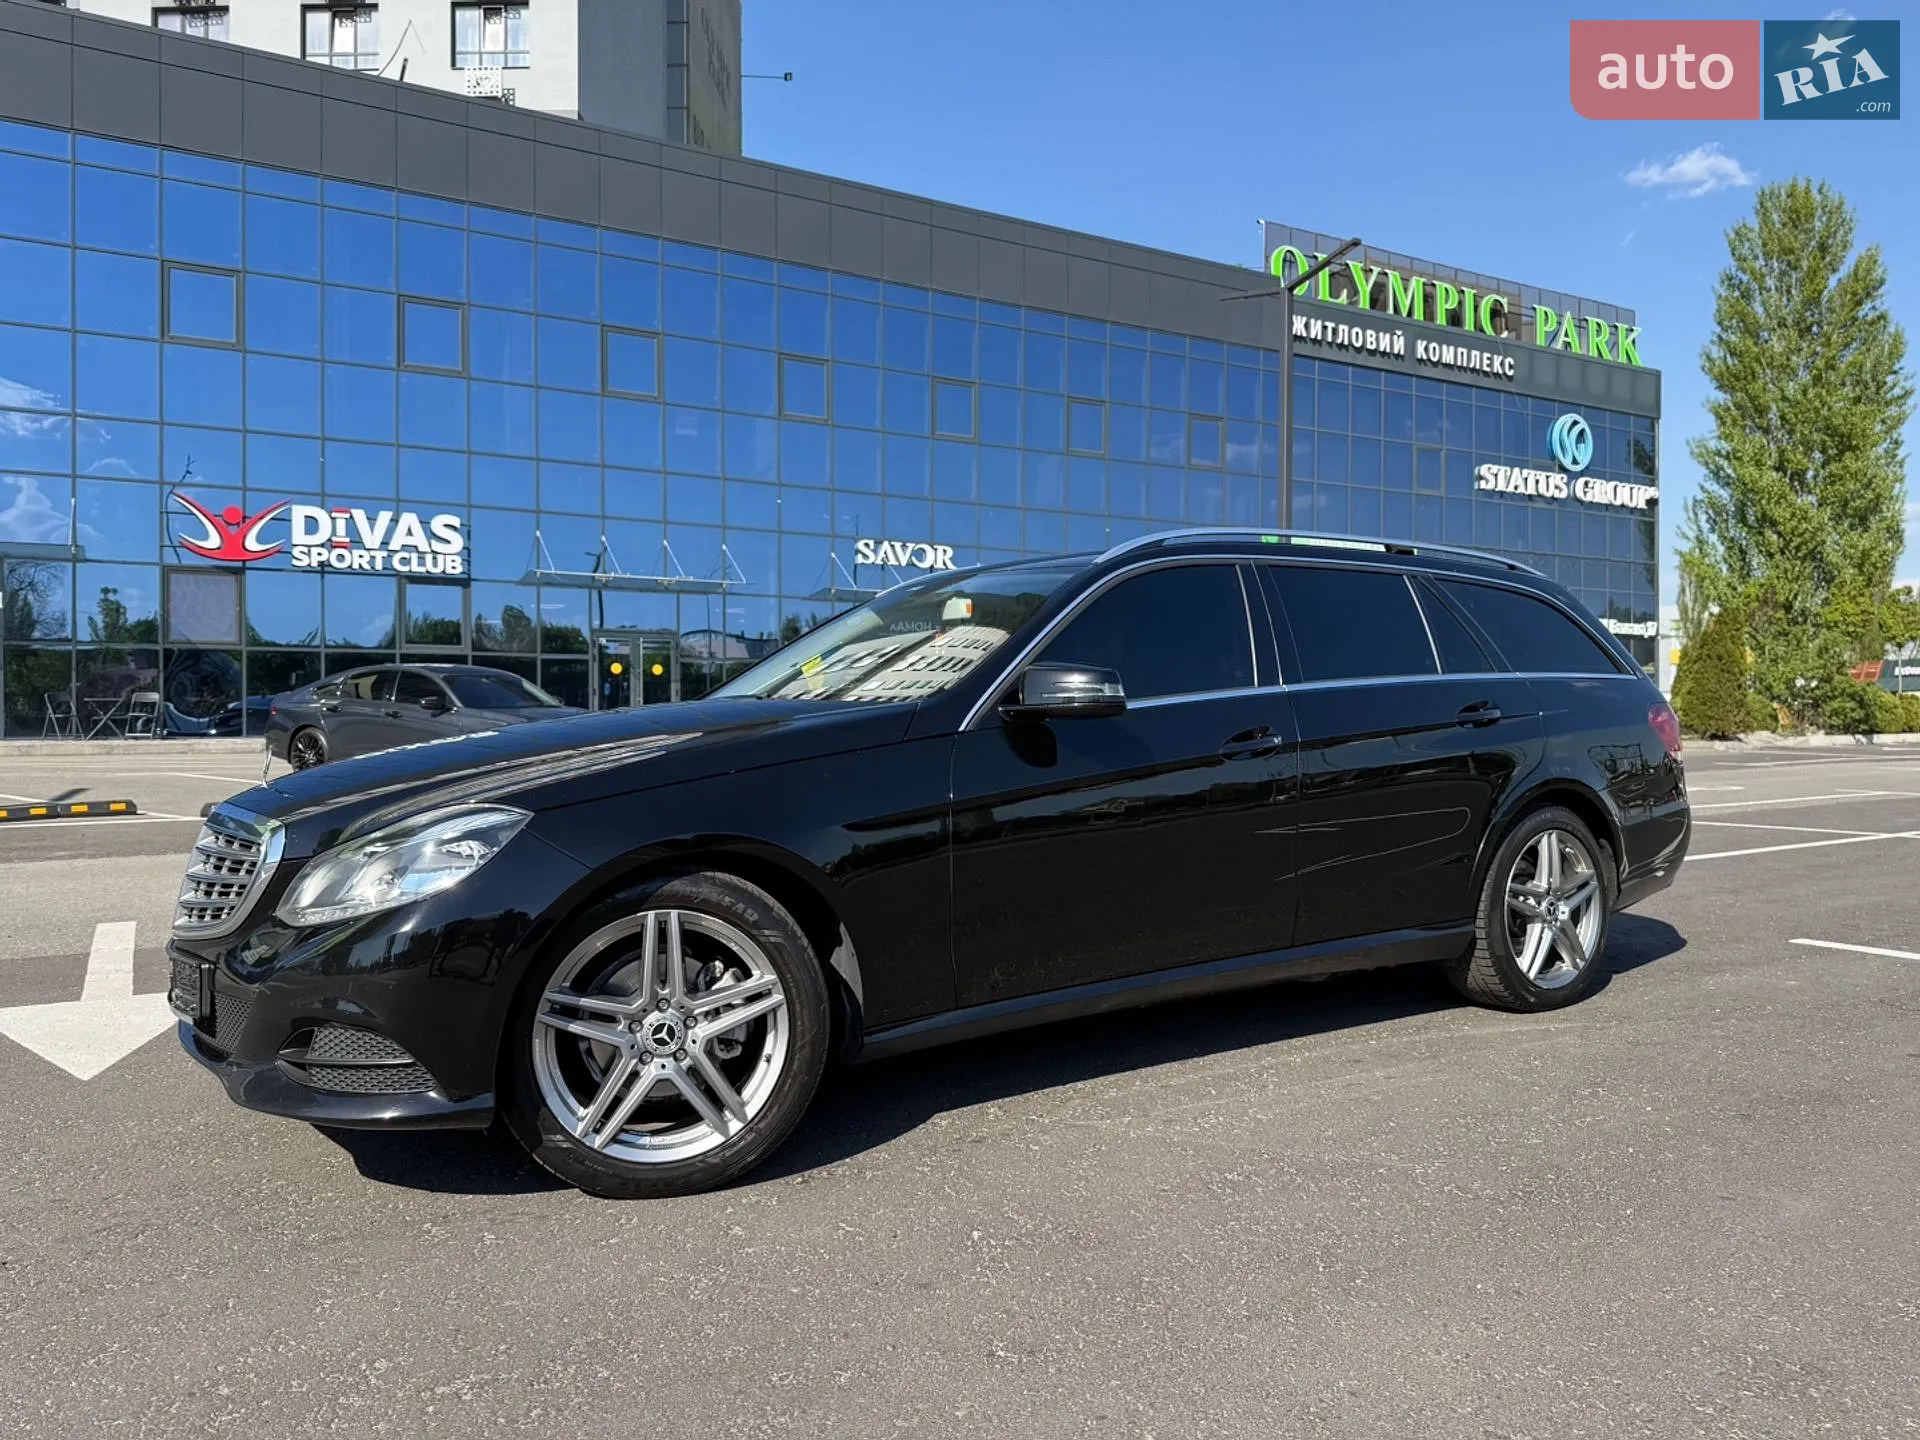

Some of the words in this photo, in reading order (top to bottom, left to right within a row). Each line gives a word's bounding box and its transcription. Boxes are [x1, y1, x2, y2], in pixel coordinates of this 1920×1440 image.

[1270, 244, 1509, 339] OLYMPIC
[1532, 303, 1643, 368] PARK
[1292, 314, 1405, 356] ЖИТЛОВИЙ
[1416, 339, 1515, 377] КОМПЛЕКС
[1477, 464, 1569, 499] STATUS
[1573, 476, 1659, 510] GROUP
[291, 546, 388, 571] SPORT
[391, 551, 464, 575] CLUB
[855, 539, 957, 570] SAVOR
